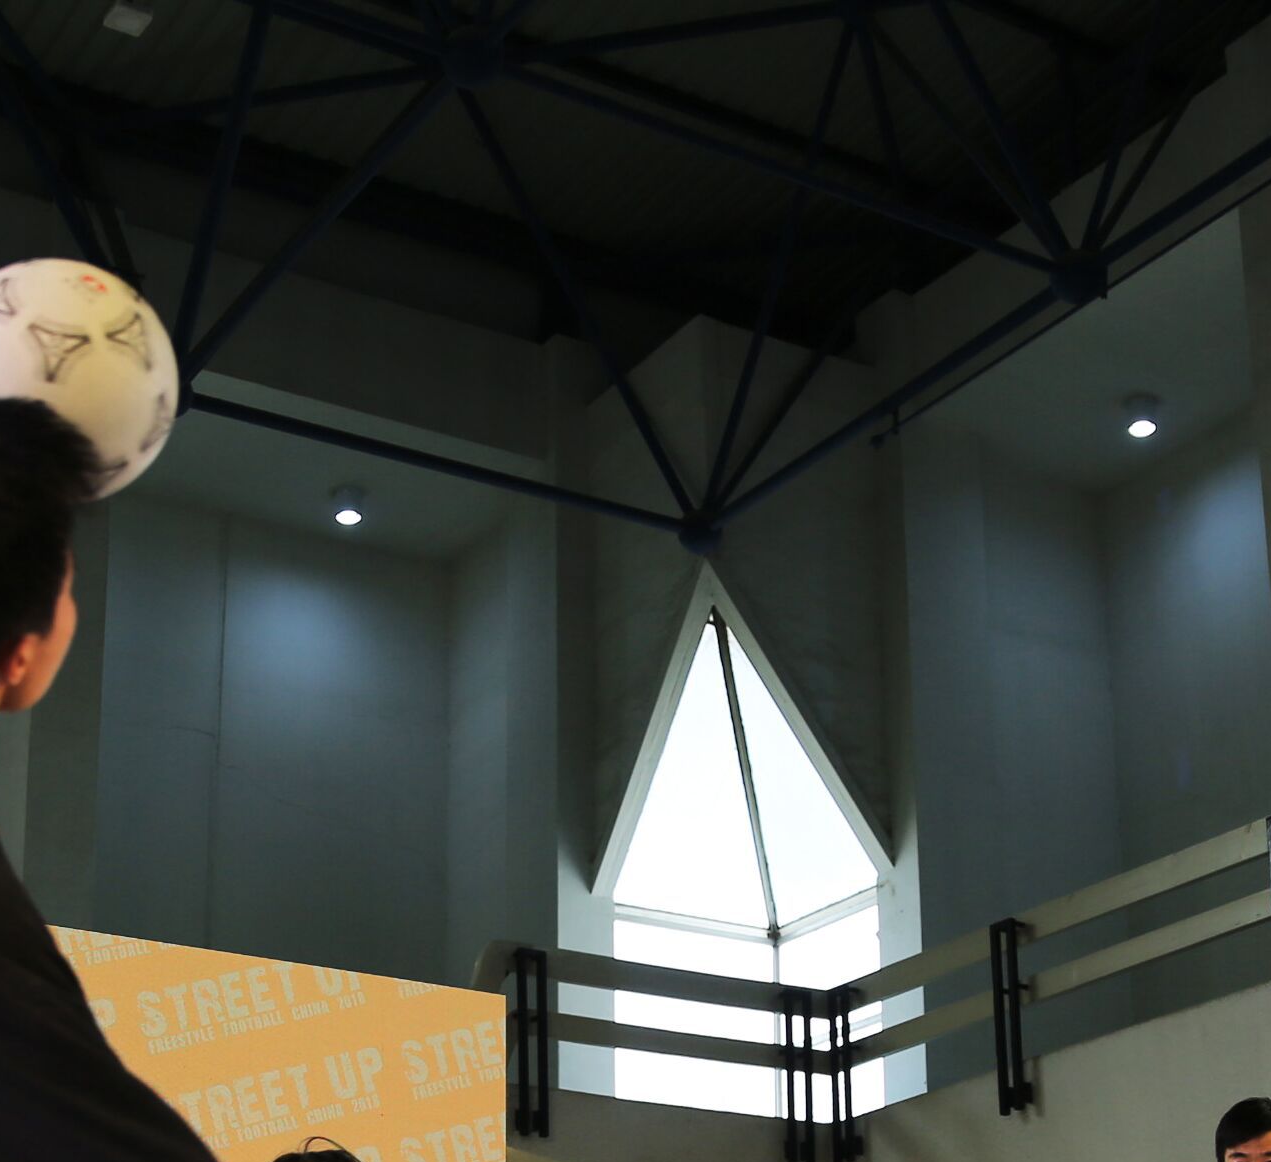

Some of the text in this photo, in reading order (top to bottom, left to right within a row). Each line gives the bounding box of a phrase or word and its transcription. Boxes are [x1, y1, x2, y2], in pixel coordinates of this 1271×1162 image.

[136, 962, 298, 1037] STREET
[147, 1025, 216, 1056] FREESTYLE
[223, 1010, 284, 1037] FOOTBALL
[292, 1000, 329, 1021] CHINA
[324, 1047, 385, 1099] UP
[400, 1017, 506, 1085] STRE
[236, 1116, 299, 1143] FOOTBALL
[413, 1073, 473, 1101] FREESTYLE
